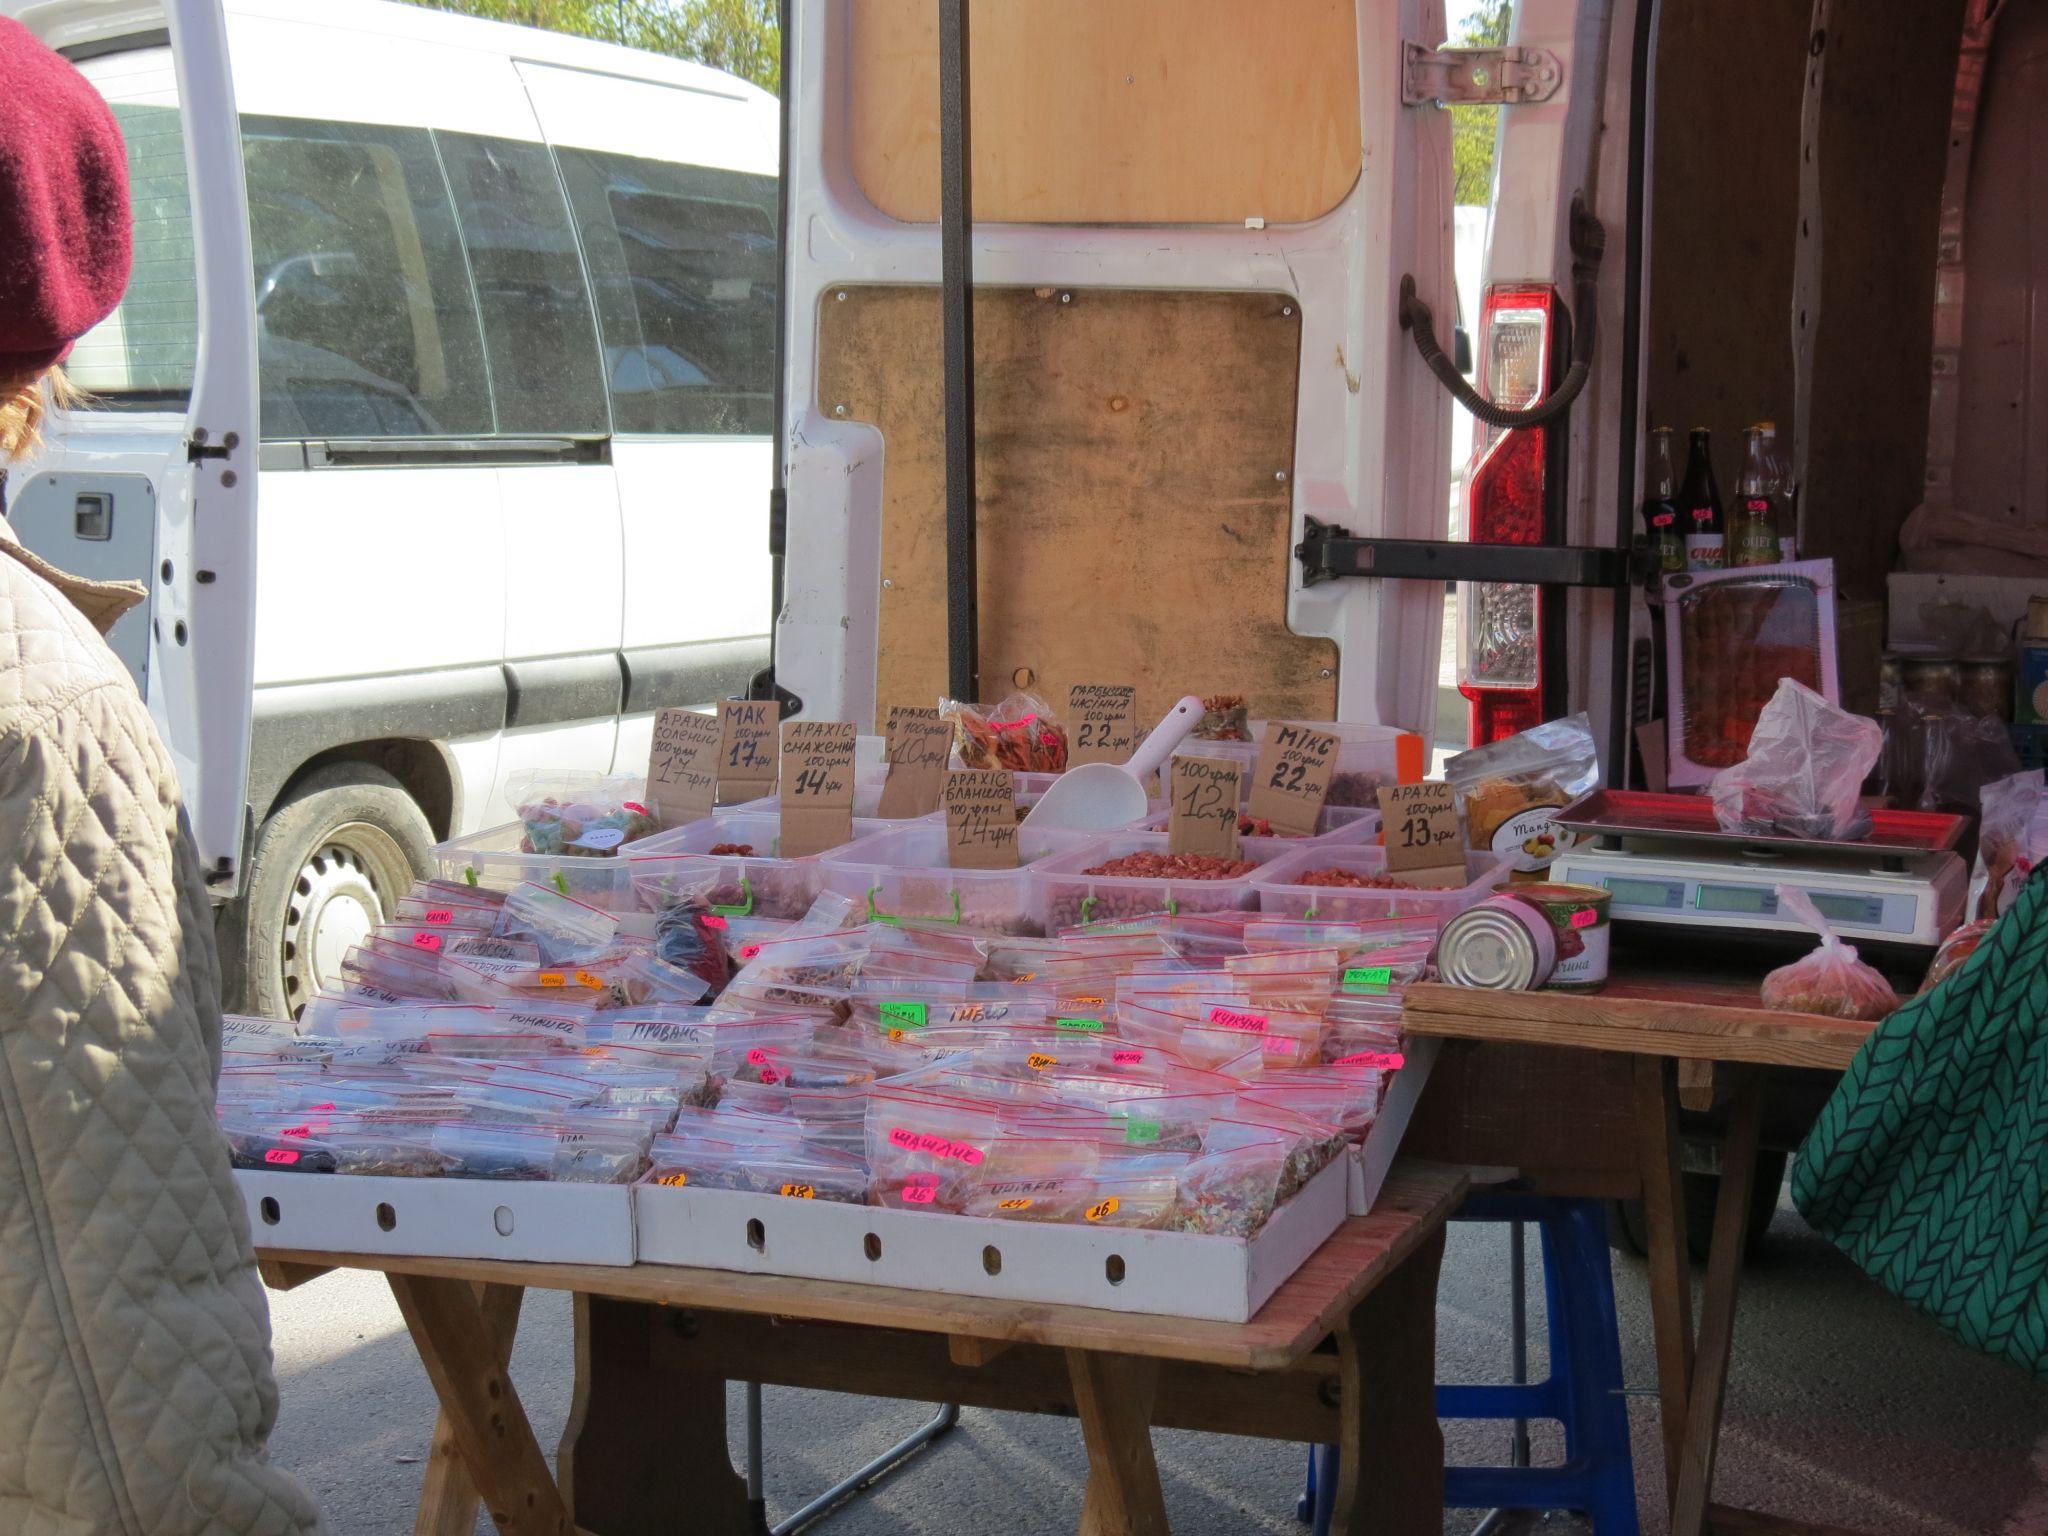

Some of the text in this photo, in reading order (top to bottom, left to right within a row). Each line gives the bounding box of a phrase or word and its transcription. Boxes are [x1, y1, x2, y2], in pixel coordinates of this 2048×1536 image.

[726, 705, 767, 725] МАК
[792, 723, 853, 738] АРАХІС
[1078, 724, 1111, 748] 22
[1276, 727, 1334, 755] МІКС
[729, 741, 757, 767] 17
[891, 738, 925, 765] 10
[656, 757, 689, 784] 17
[794, 769, 828, 795] 14
[947, 772, 1007, 788] АРАХІС
[1180, 763, 1209, 777] 100
[1270, 761, 1307, 792] 22
[1181, 783, 1222, 819] 12
[1391, 784, 1448, 801] АРАХІС
[950, 804, 967, 815] 100
[958, 813, 988, 846] 14
[1400, 818, 1431, 847] 13
